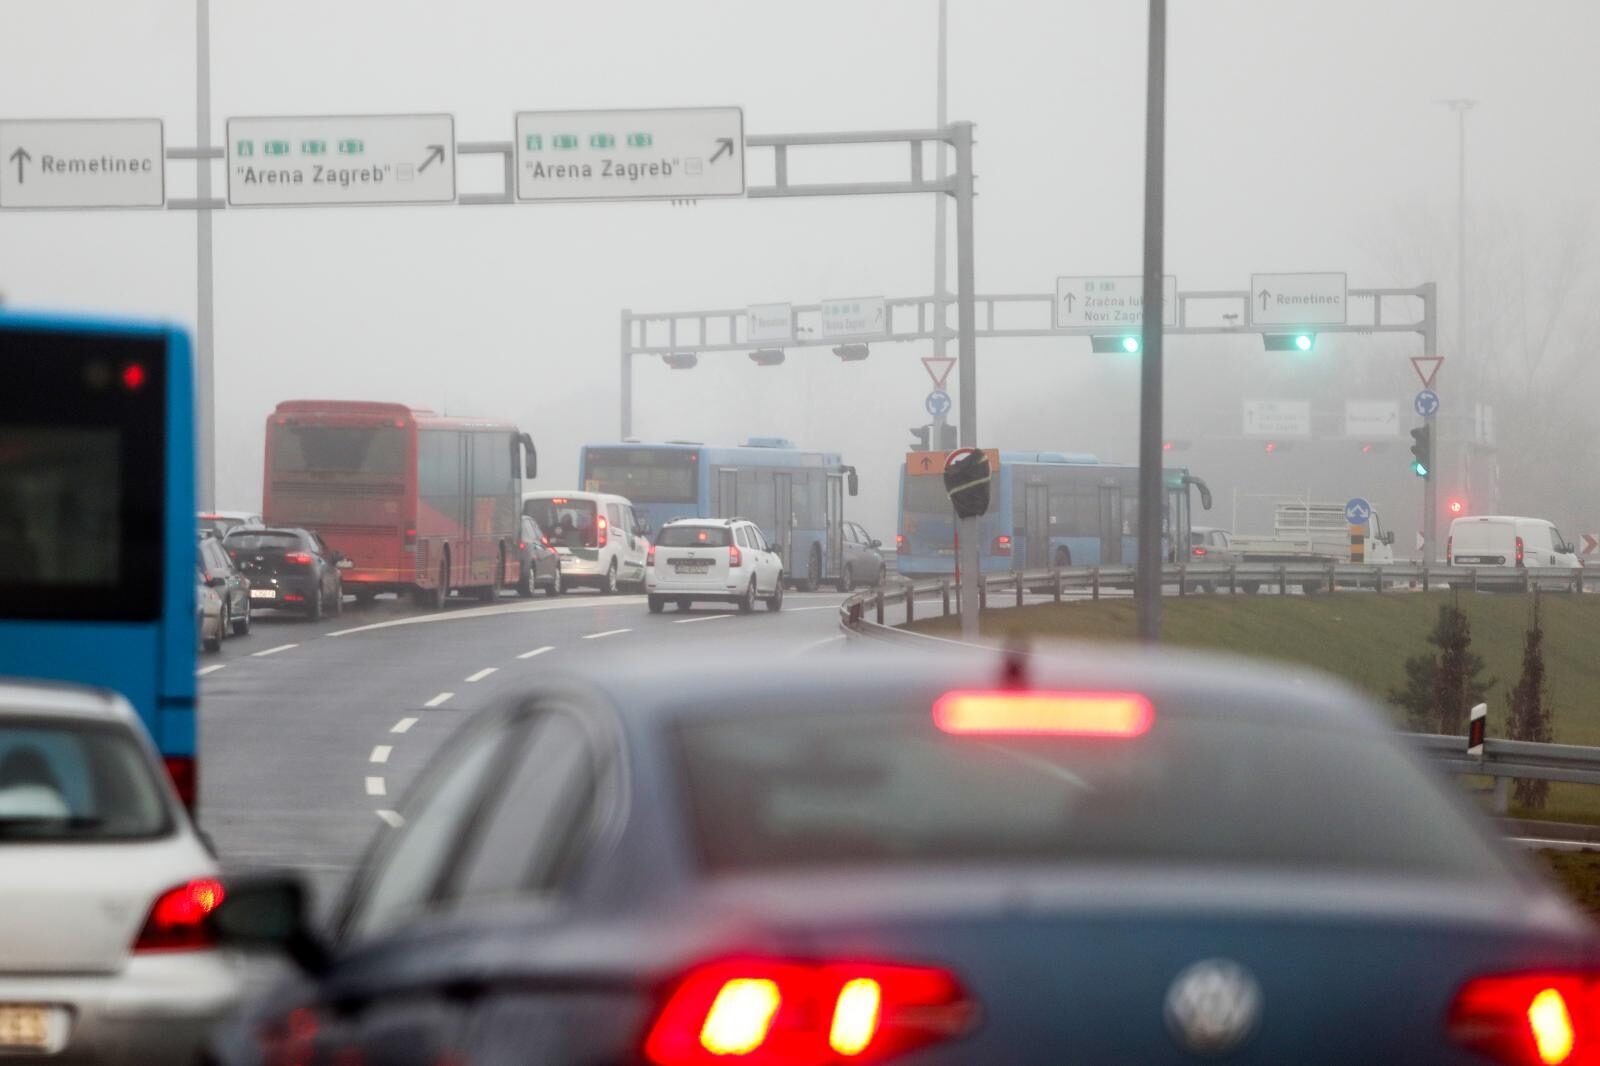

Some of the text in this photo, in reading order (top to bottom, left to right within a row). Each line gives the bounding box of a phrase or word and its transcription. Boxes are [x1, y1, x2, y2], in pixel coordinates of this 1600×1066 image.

[41, 154, 153, 174] Remetinec
[526, 158, 679, 181] "Arena Zagreb"
[237, 163, 391, 187] "Arena Zagreb"
[1276, 292, 1341, 305] Remetinec
[1084, 309, 1144, 324] Novi Zagr
